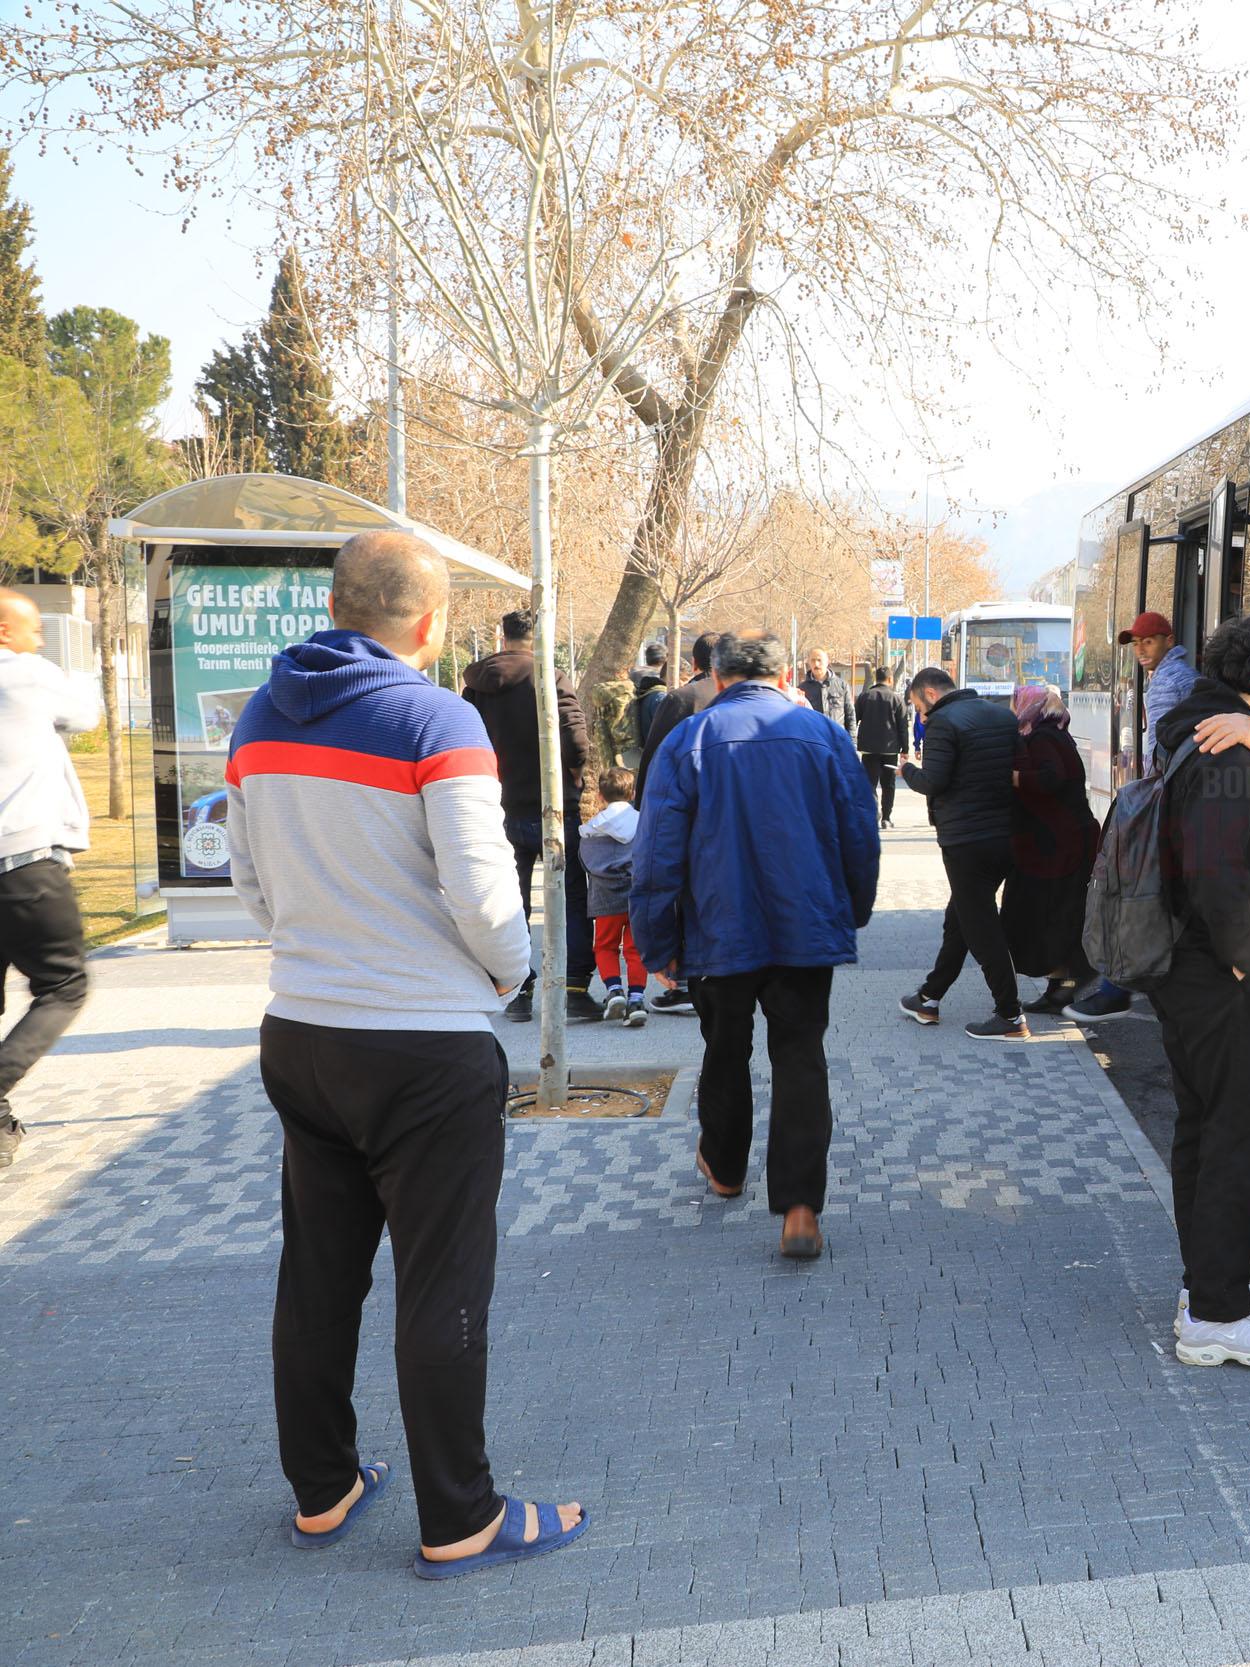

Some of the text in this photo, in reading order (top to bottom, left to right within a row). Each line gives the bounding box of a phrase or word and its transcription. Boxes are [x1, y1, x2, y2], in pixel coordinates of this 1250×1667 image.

[186, 584, 330, 608] GELECEK TAR
[192, 613, 335, 637] UMUT TOPR
[197, 657, 231, 670] Tarım
[233, 657, 263, 670] Kenti
